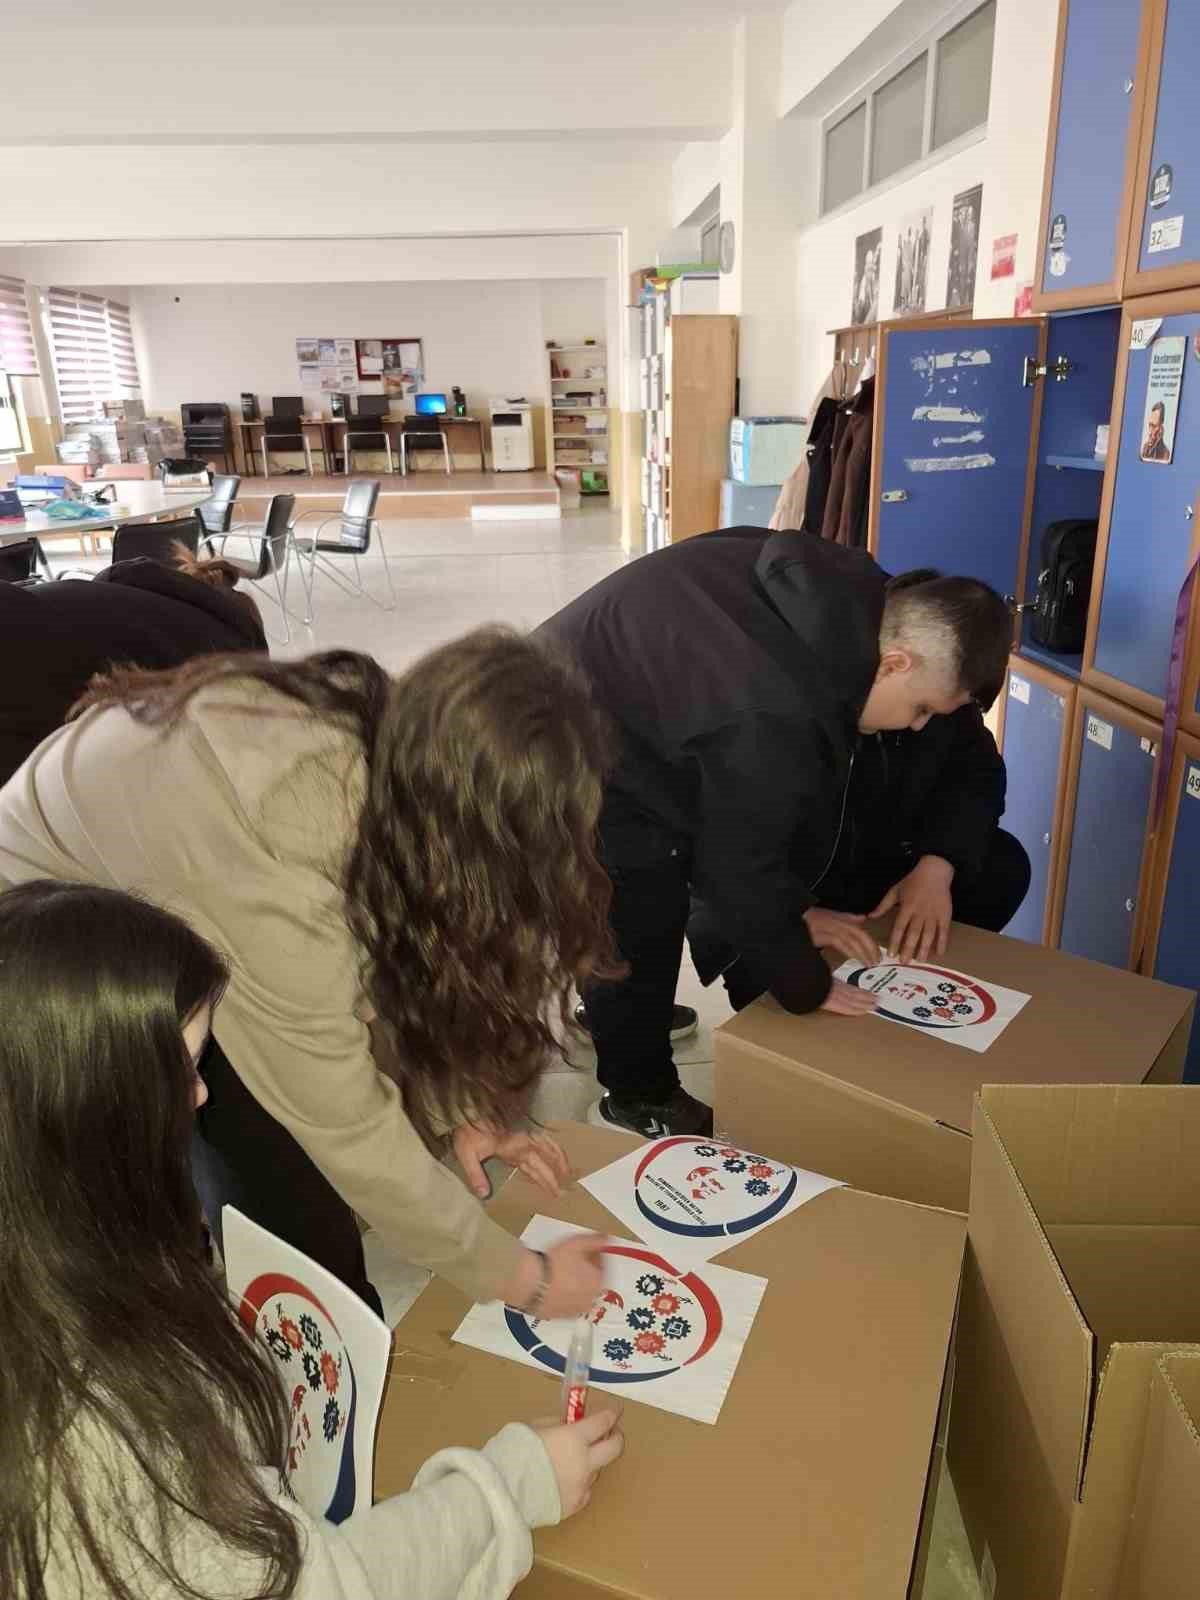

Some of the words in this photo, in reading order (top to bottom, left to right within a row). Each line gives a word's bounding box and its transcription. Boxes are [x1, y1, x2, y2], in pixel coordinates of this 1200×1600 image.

[1151, 229, 1163, 246] 32
[1132, 328, 1143, 344] 40
[1088, 722, 1098, 737] 48
[1189, 775, 1200, 792] 49
